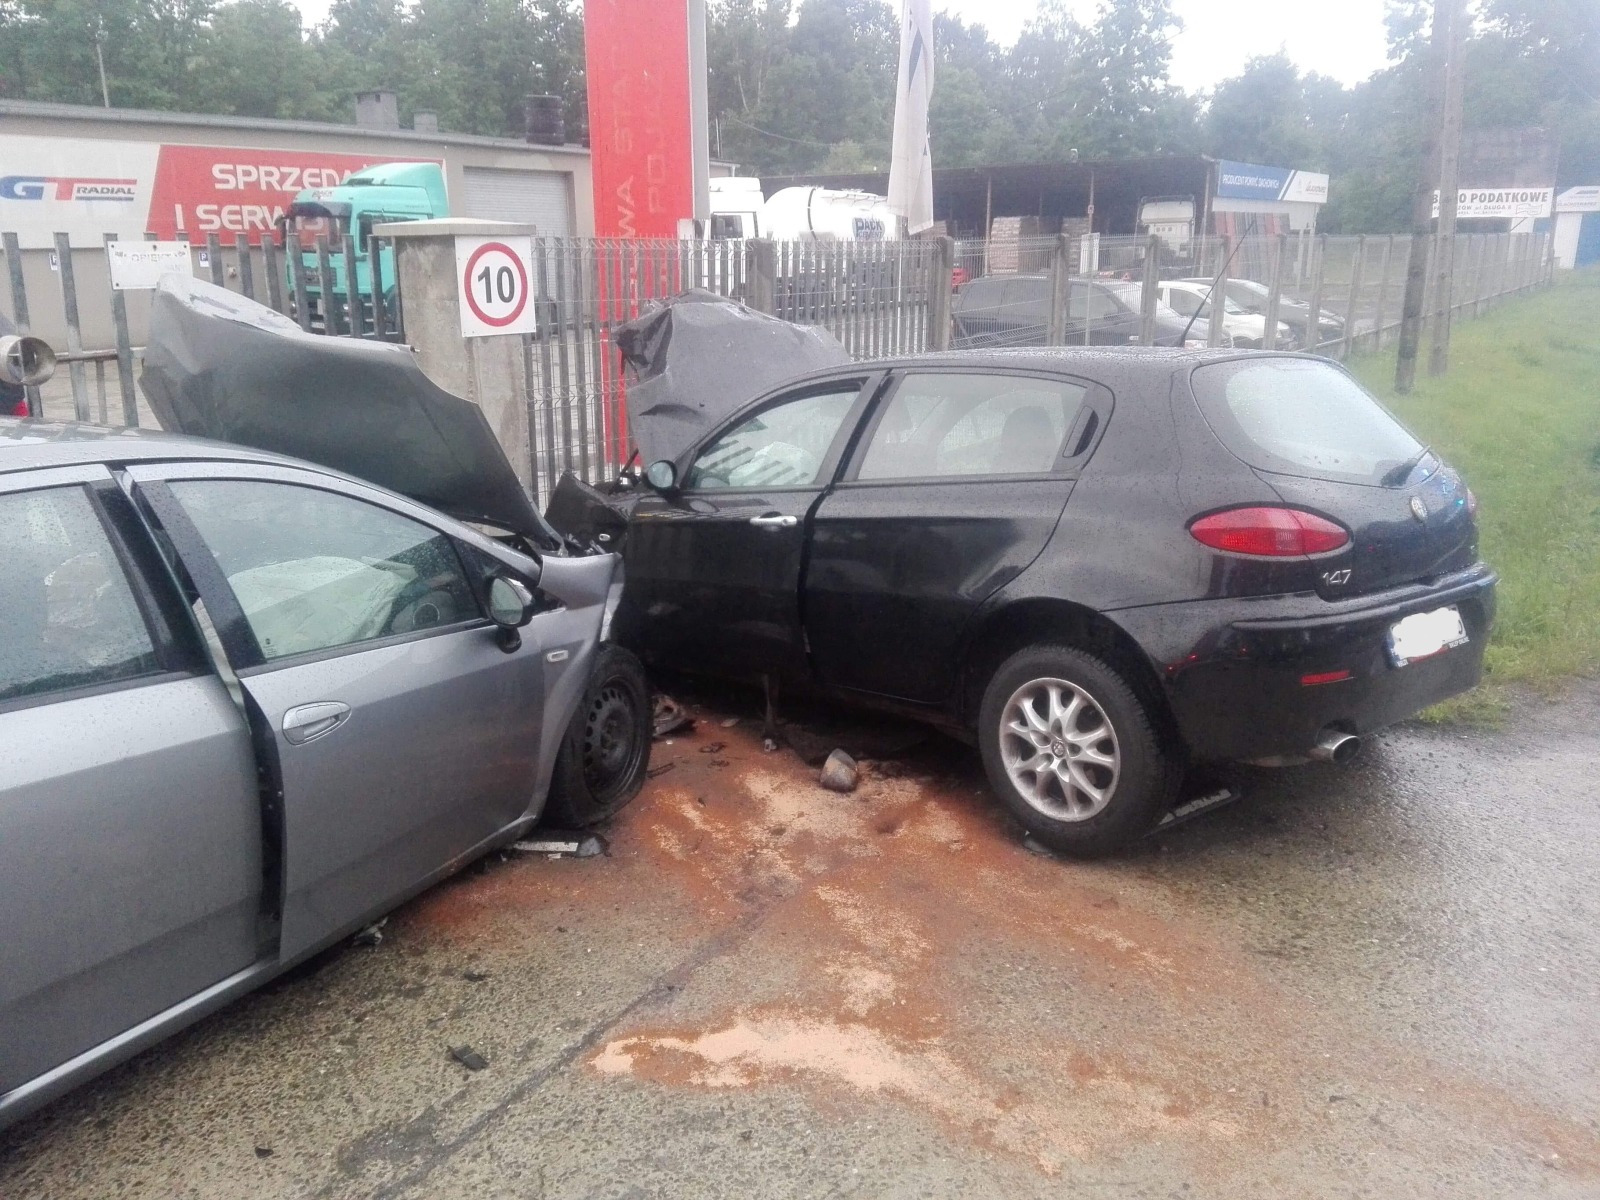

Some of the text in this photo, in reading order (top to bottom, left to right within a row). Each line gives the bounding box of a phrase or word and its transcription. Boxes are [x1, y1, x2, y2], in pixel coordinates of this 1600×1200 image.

[212, 164, 352, 191] SPRZED
[77, 186, 134, 195] RADIAL
[1470, 192, 1549, 204] PODATKOWE
[175, 204, 185, 230] I
[855, 217, 883, 238] PACK
[477, 265, 515, 304] 10
[1322, 569, 1352, 586] 147
